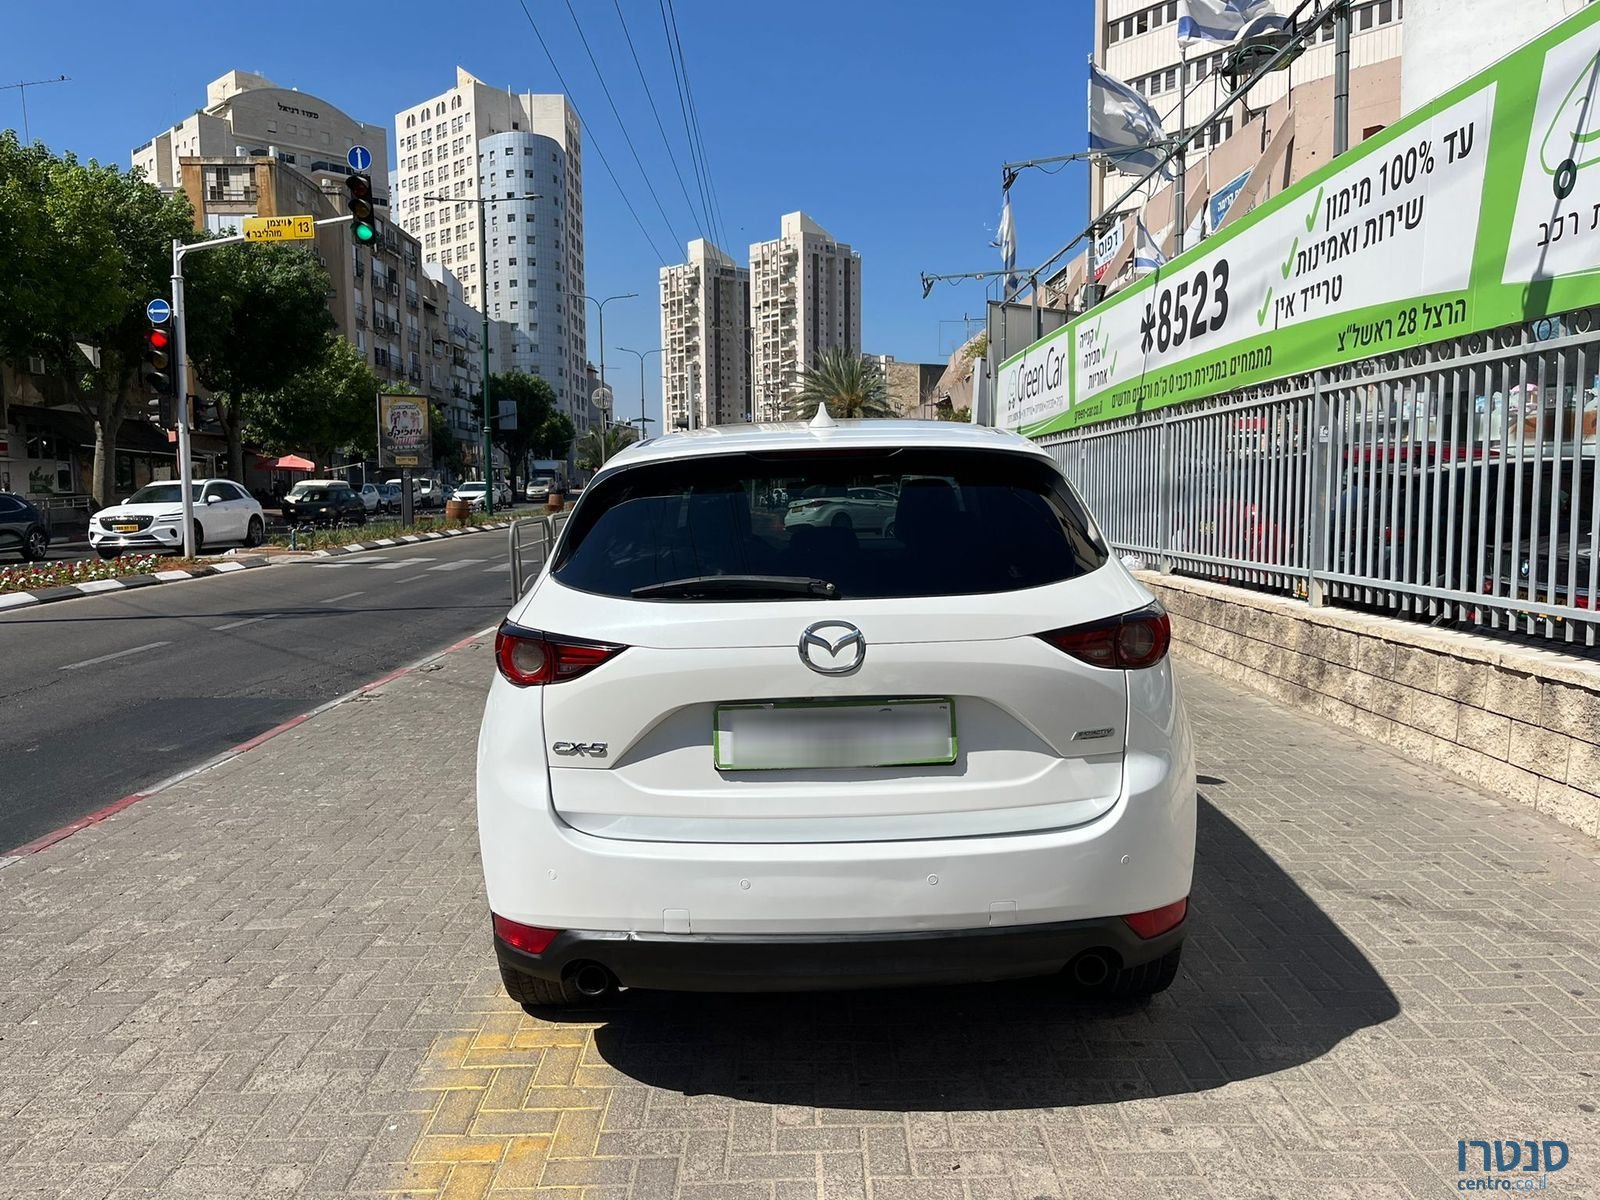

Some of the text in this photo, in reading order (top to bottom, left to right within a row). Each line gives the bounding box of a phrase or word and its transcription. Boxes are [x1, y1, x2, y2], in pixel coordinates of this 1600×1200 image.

[1325, 121, 1475, 232] עד 100% מימון
[251, 228, 282, 238] מוהליבר
[266, 218, 287, 229] ויצמן
[297, 221, 310, 233] 13
[1536, 211, 1579, 247] רכב
[1098, 230, 1119, 258] דפוס
[1295, 194, 1425, 278] שירות ואמינות
[1274, 274, 1343, 330] טרייד אין
[1396, 307, 1418, 338] 28
[1422, 298, 1467, 331] הרצל
[1079, 328, 1094, 349] קנייה
[1083, 348, 1101, 369] מכירה
[1229, 345, 1272, 377] מתמחים
[1017, 346, 1066, 403] Green Car
[1087, 367, 1108, 390] אחריות
[1168, 372, 1175, 394] 0
[1175, 372, 1193, 391] רכבי
[1193, 361, 1227, 386] במכירת
[1111, 388, 1131, 409] חדשים
[1132, 382, 1153, 403] ורכבים
[552, 741, 608, 758] CX-5
